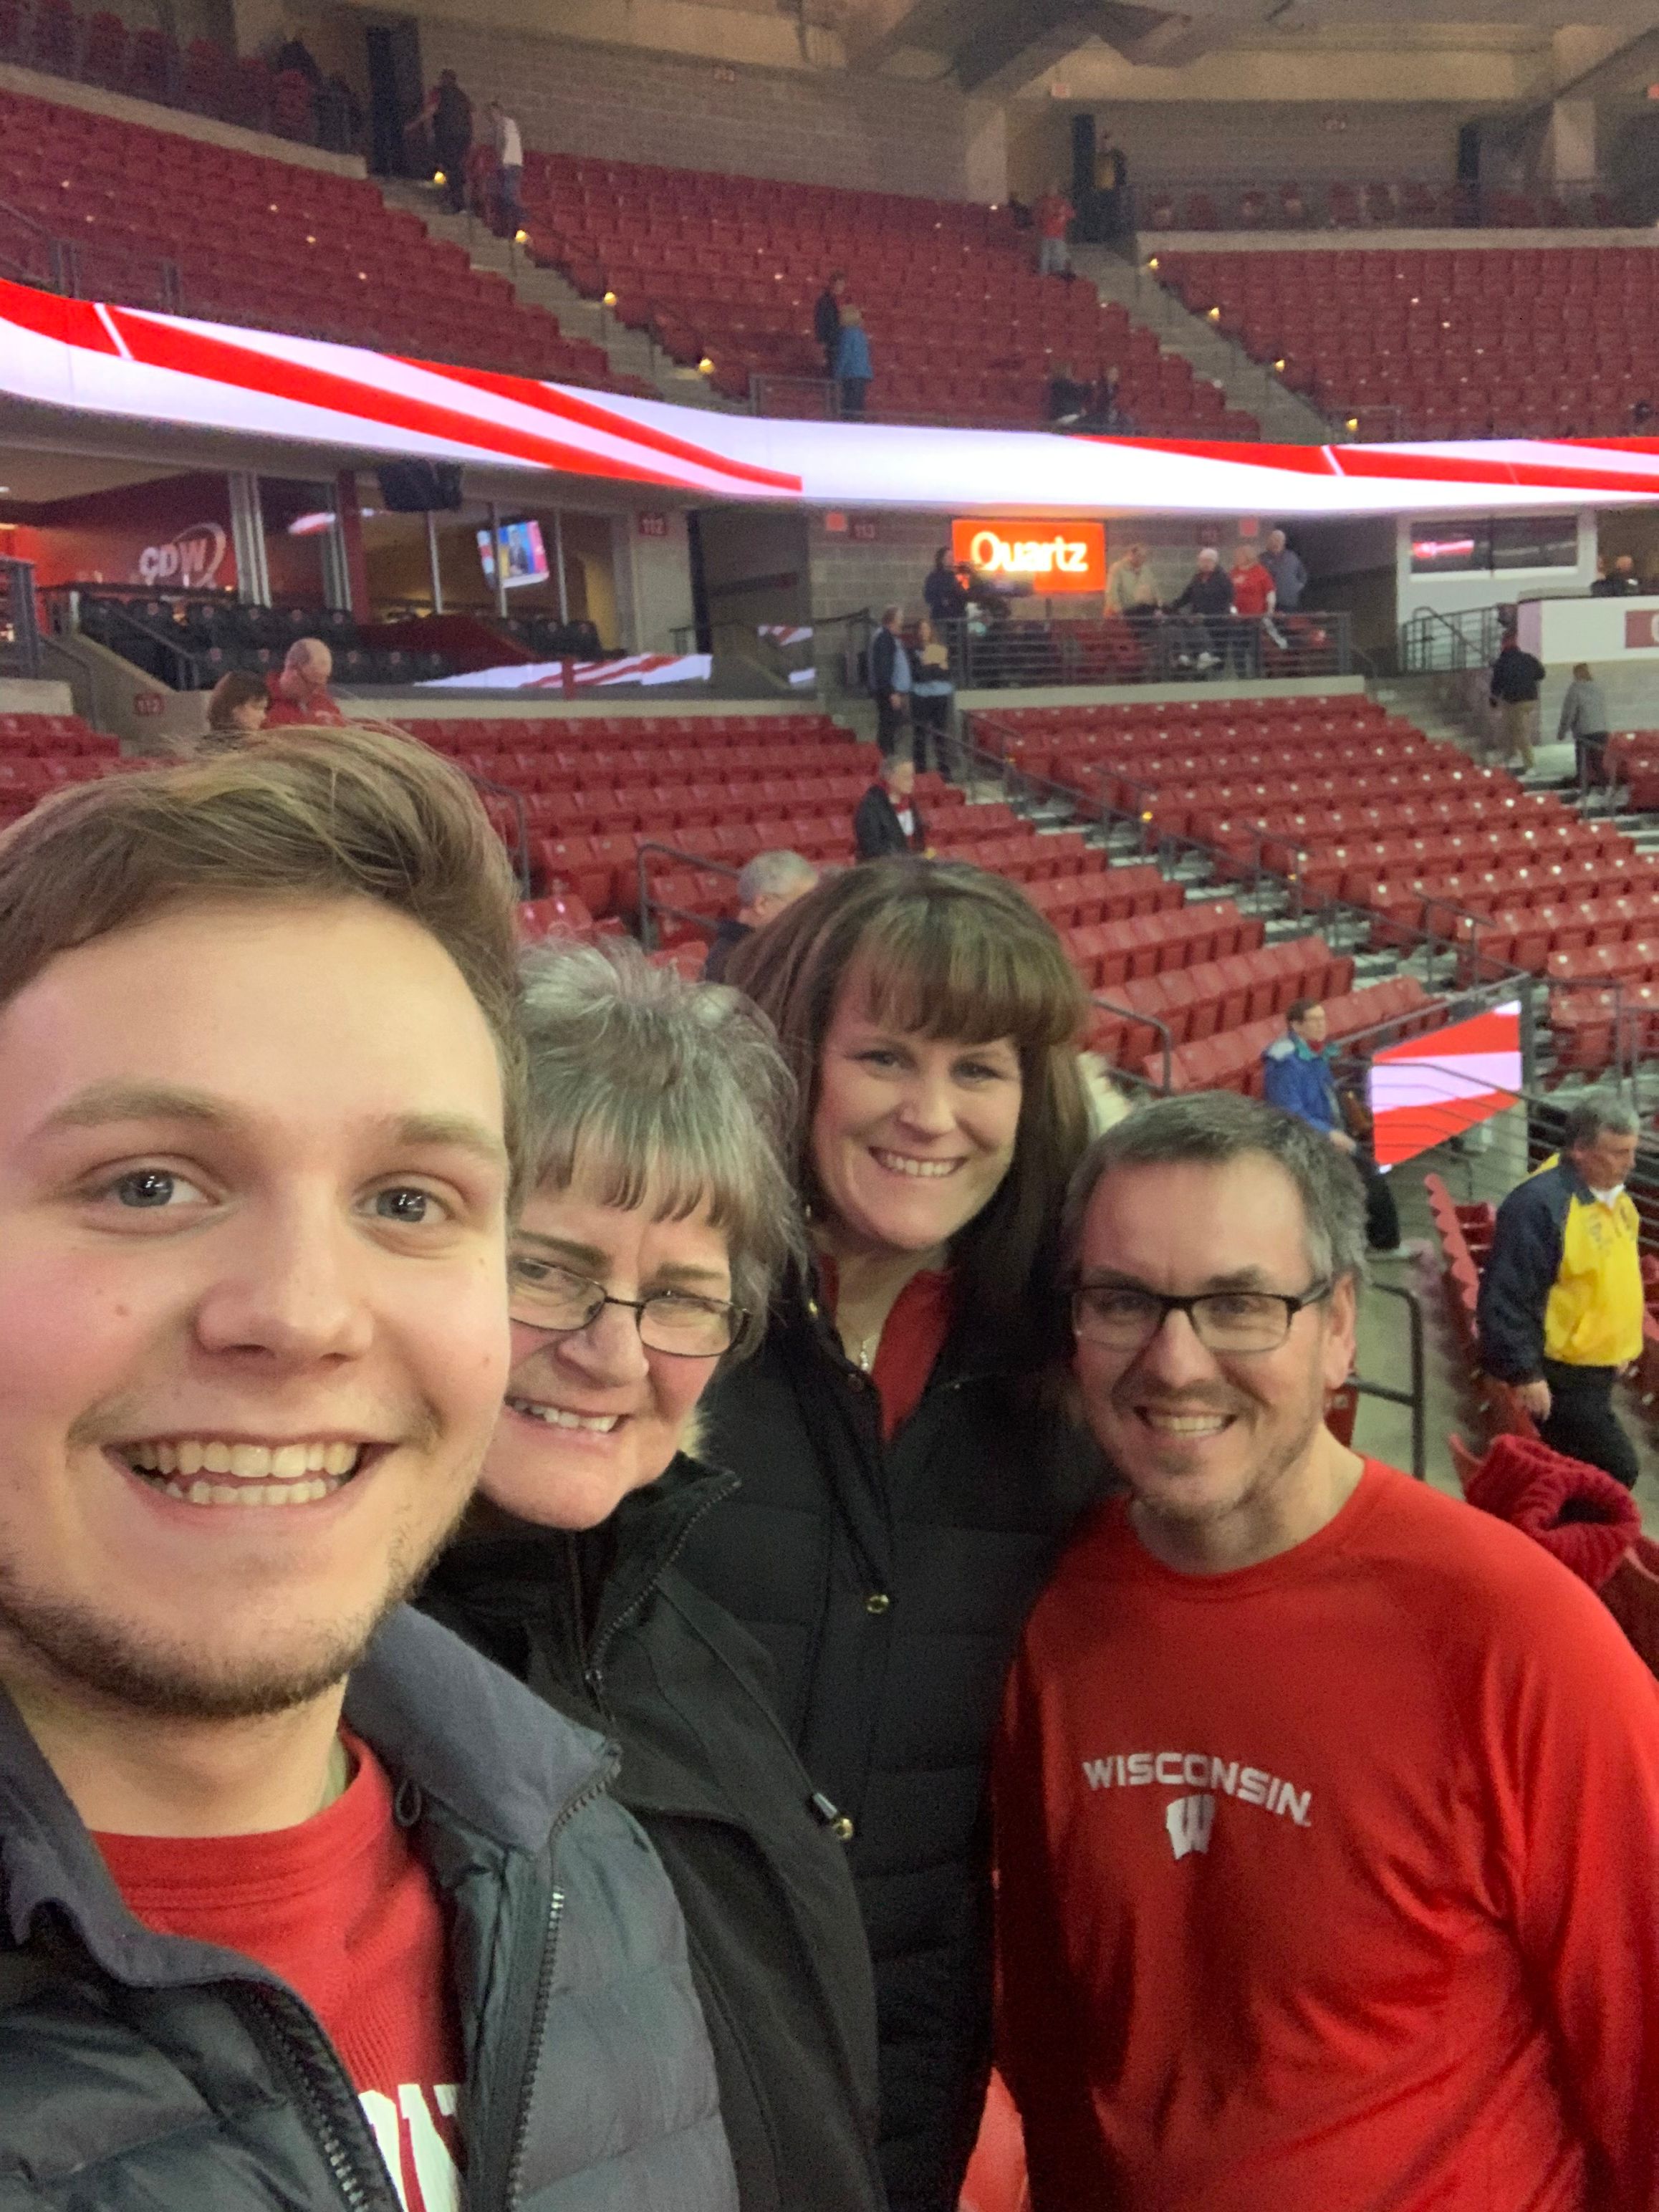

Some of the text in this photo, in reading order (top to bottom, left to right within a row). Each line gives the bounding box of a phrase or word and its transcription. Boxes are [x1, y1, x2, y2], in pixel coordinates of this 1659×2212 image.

[139, 539, 207, 577] CDW
[971, 531, 1089, 572] Quartz
[1082, 1752, 1312, 1827] WISCONSIN
